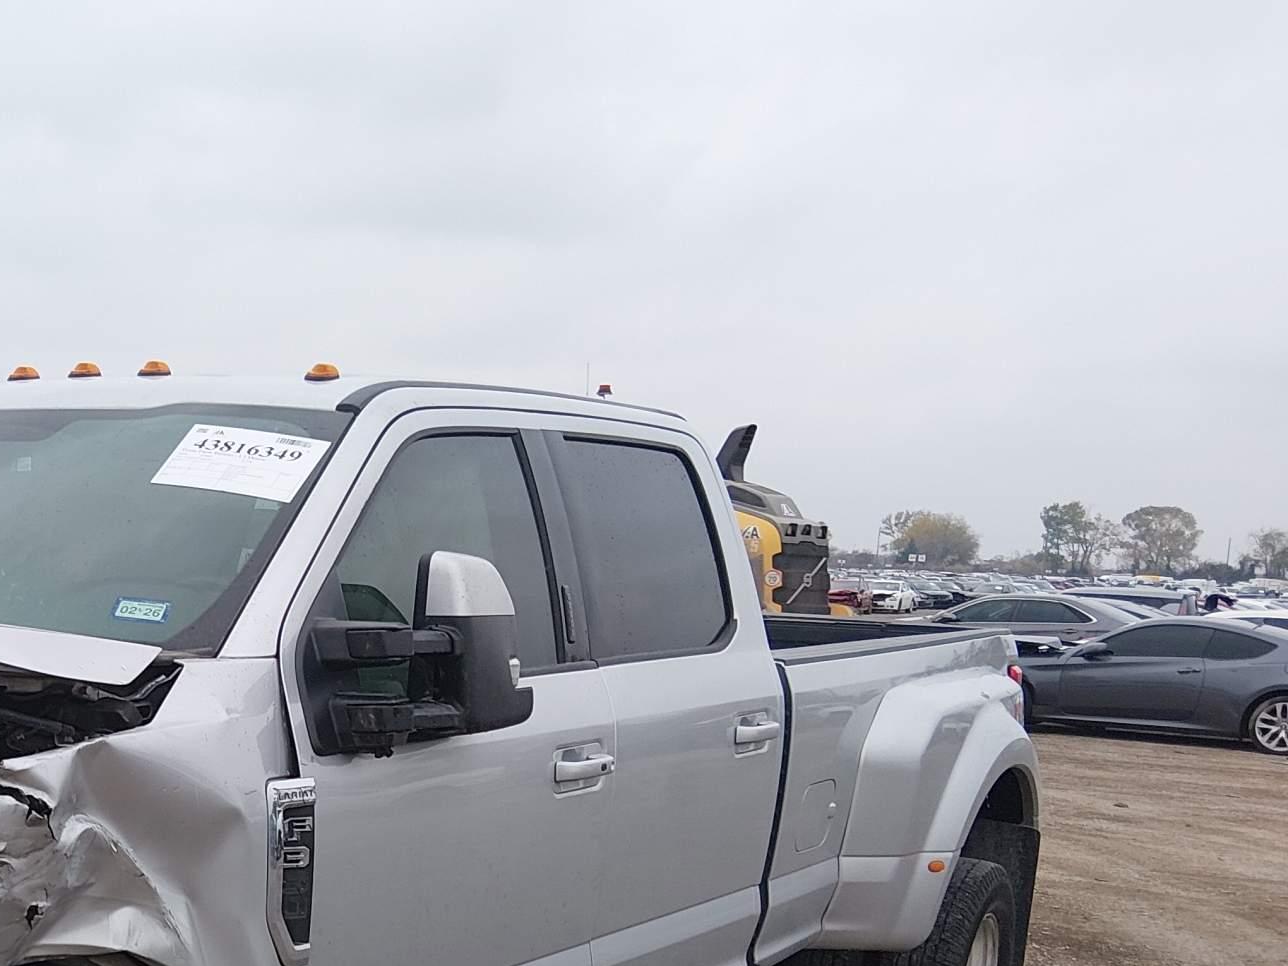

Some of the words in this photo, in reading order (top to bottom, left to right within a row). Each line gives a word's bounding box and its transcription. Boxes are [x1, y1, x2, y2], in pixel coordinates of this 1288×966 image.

[194, 438, 303, 462] 43816349
[120, 605, 138, 615] 02
[143, 607, 162, 618] 26
[278, 789, 314, 801] LARIAT
